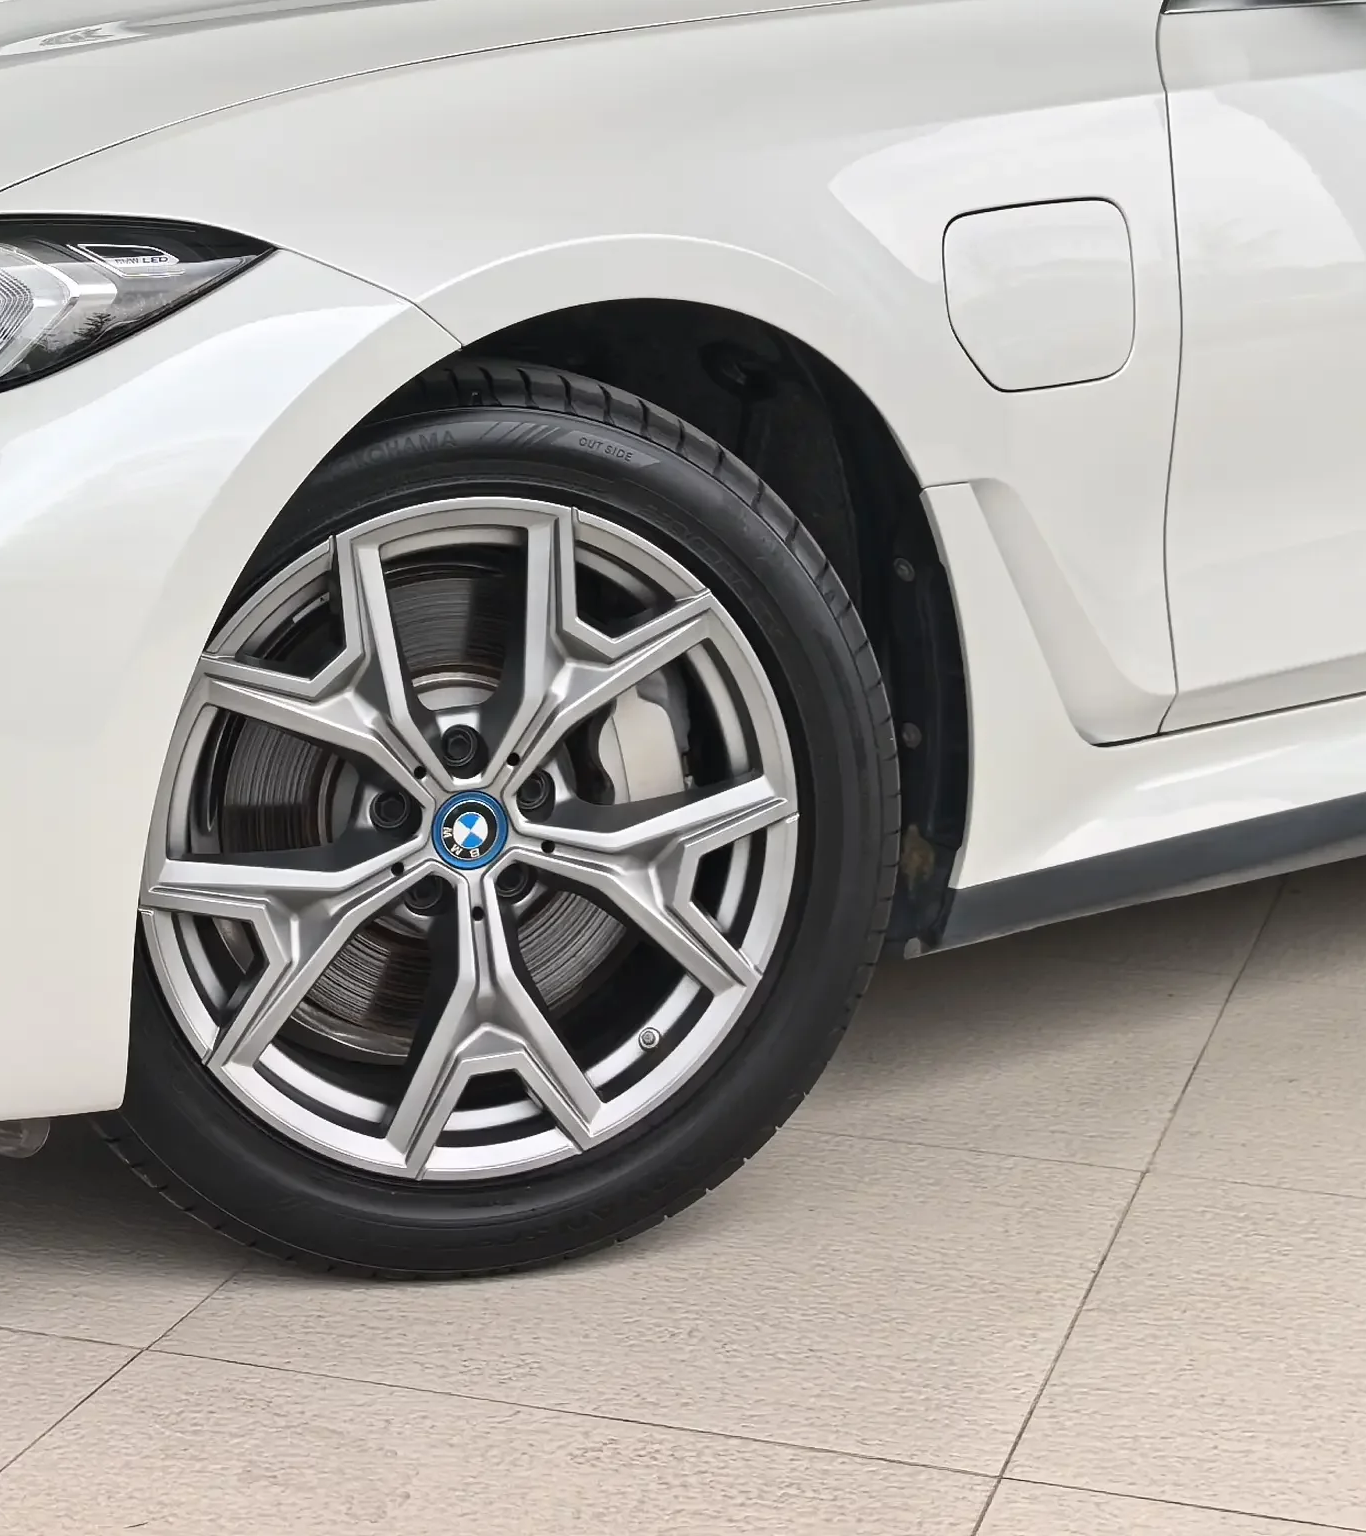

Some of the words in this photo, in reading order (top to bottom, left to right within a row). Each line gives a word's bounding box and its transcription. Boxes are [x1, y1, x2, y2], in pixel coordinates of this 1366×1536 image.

[143, 256, 169, 264] LED
[578, 436, 603, 451] OUT
[604, 442, 633, 463] SIDE
